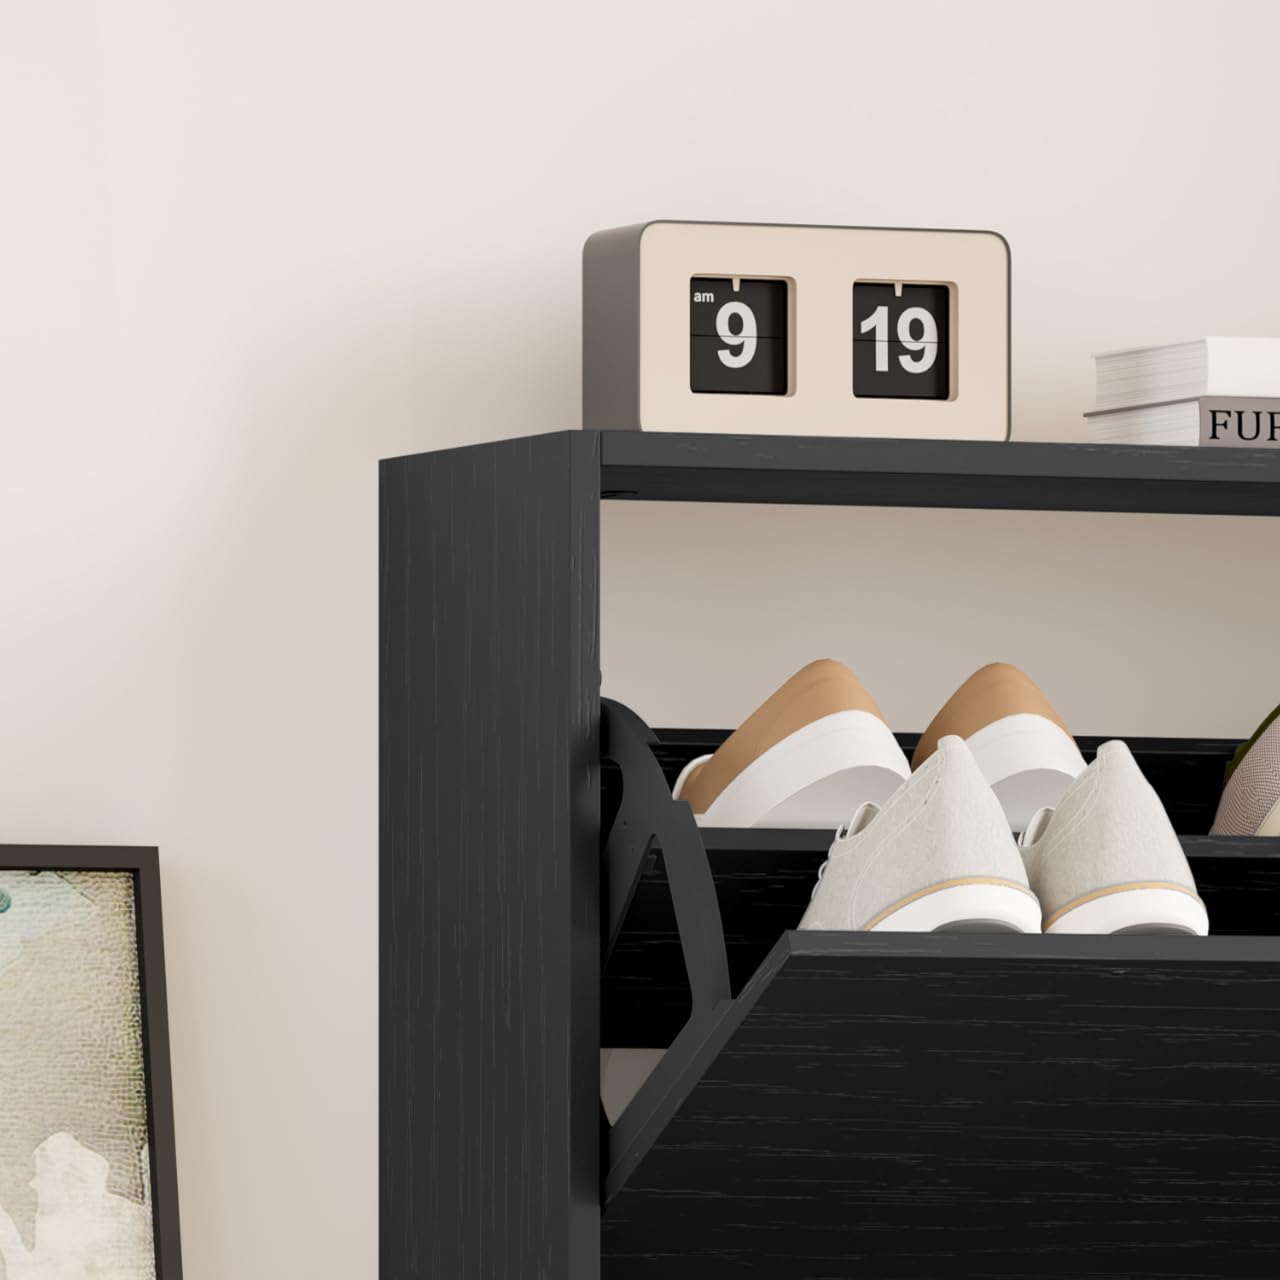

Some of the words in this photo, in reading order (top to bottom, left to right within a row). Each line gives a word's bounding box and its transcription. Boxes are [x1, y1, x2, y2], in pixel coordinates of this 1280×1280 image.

[693, 291, 715, 304] am
[715, 301, 758, 369] 9
[860, 305, 939, 374] 19
